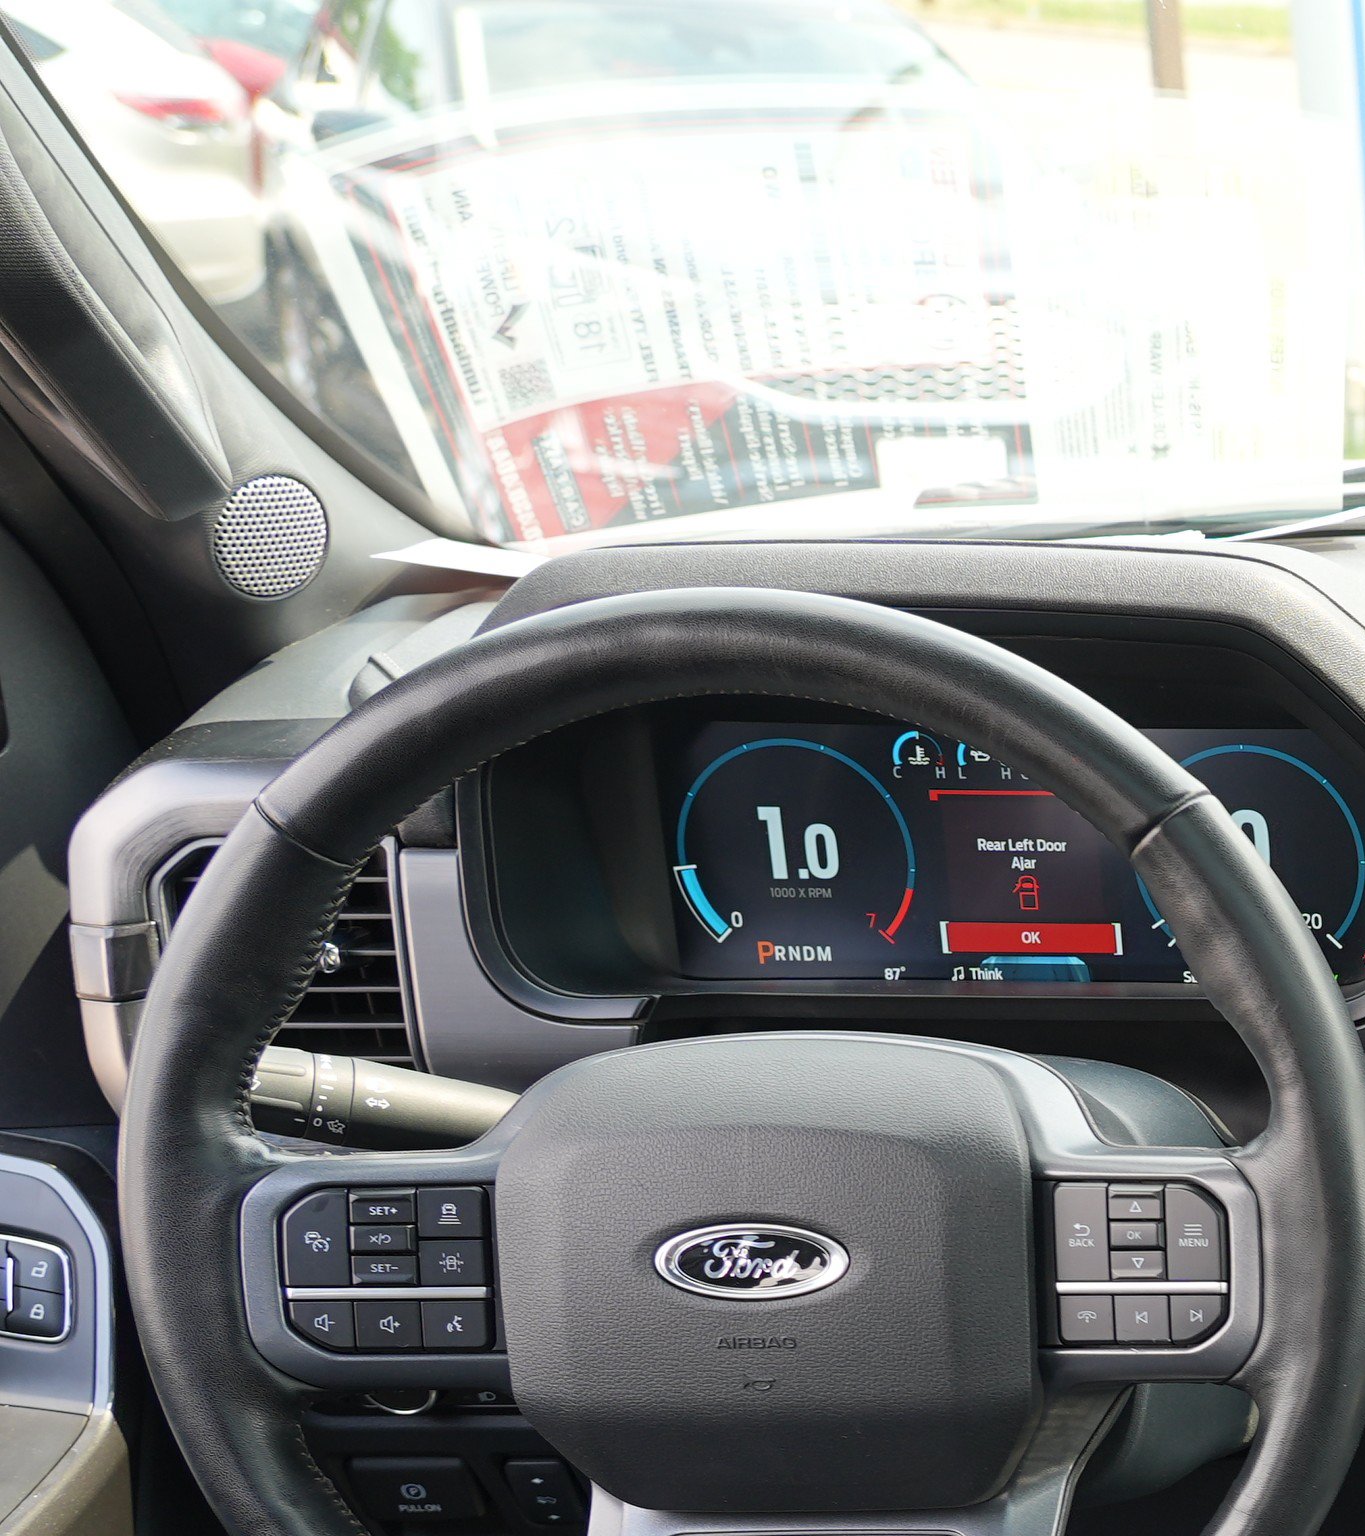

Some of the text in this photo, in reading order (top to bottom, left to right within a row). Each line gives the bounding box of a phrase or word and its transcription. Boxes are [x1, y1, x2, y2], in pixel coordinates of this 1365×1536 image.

[893, 766, 946, 779] C H
[958, 768, 1011, 779] L H
[757, 806, 840, 880] 1.0
[977, 838, 1067, 852] Rear Left Door
[1011, 857, 1037, 871] Ajar
[770, 887, 832, 898] 1000 X RPM
[730, 911, 744, 928] 0
[866, 913, 877, 929] 7
[1021, 931, 1041, 944] OK
[969, 967, 1003, 981] Think
[369, 1206, 398, 1215] SET+
[1127, 1231, 1141, 1240] OK
[1069, 1238, 1095, 1247] BACK
[1178, 1238, 1209, 1247] MENU
[701, 1235, 800, 1279] Ford
[717, 1337, 797, 1349] AIRBAG
